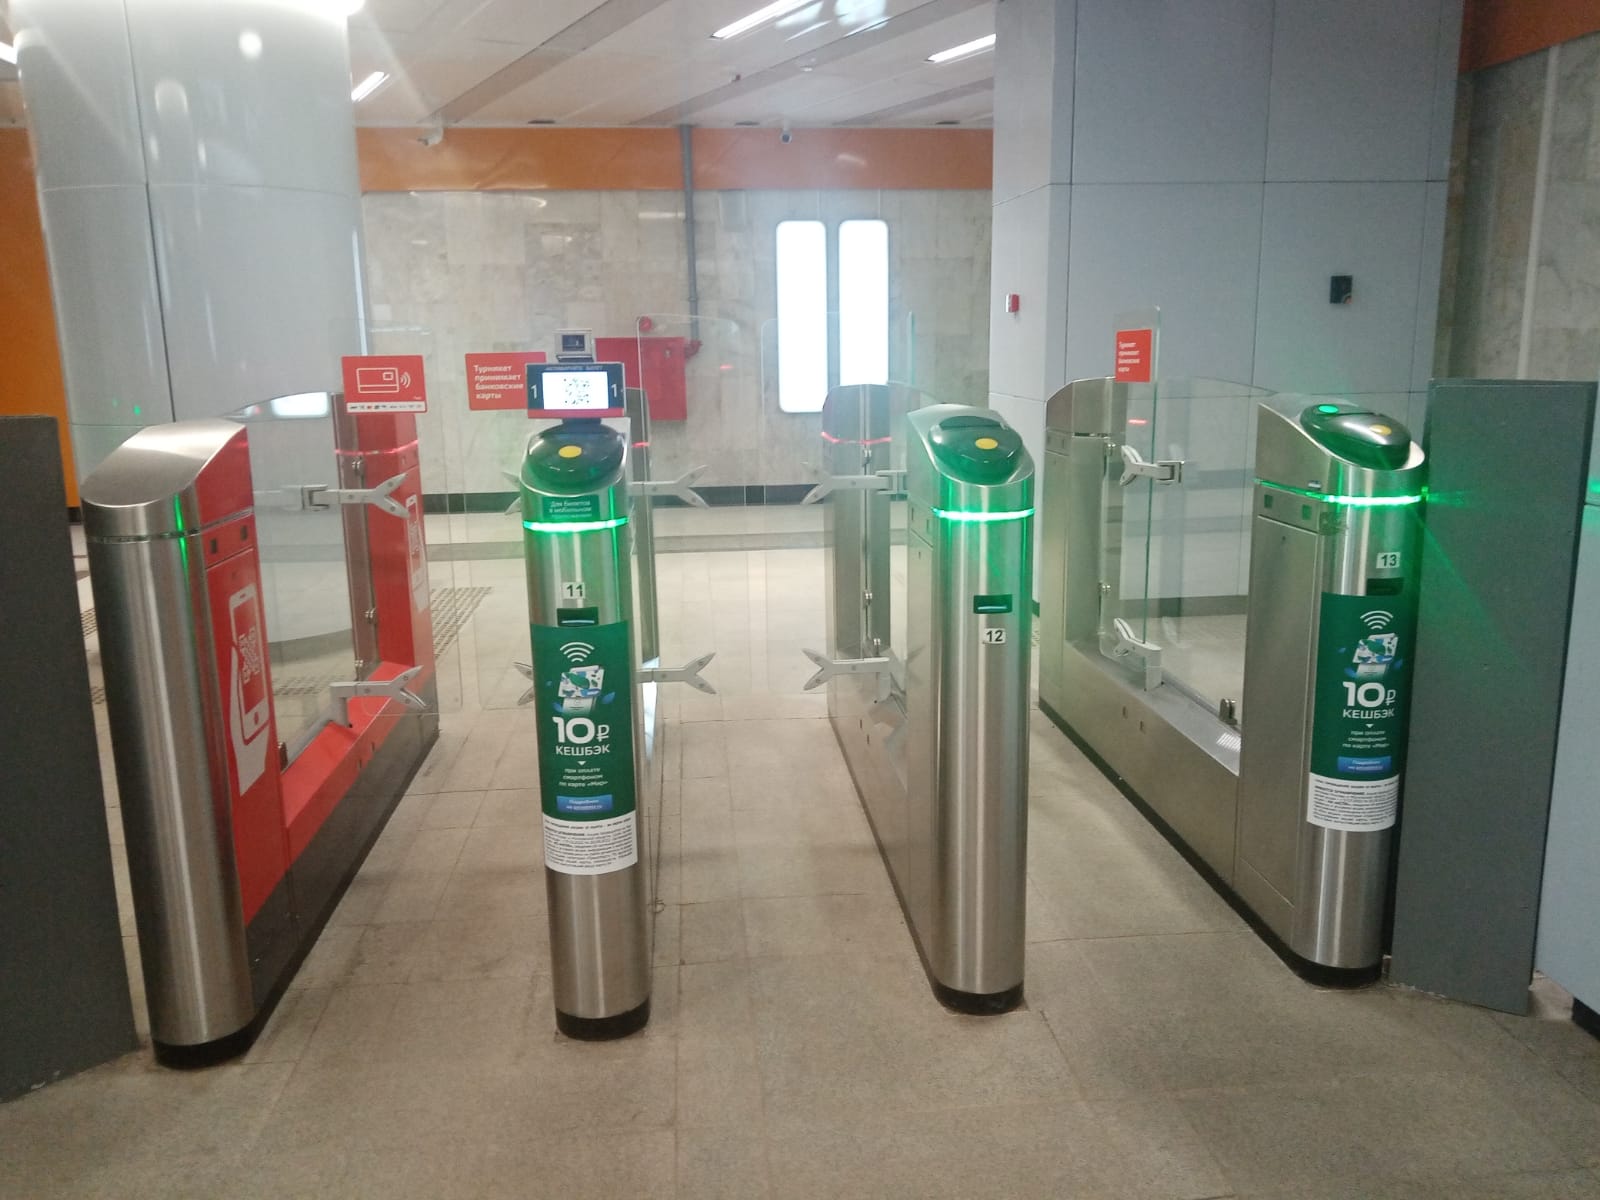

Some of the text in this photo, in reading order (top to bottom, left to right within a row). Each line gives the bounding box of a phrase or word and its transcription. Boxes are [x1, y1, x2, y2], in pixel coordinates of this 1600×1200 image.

[530, 384, 538, 399] 1
[611, 383, 618, 398] 1
[1381, 554, 1397, 567] 13
[566, 584, 584, 597] 11
[986, 630, 1003, 643] 12
[1343, 708, 1394, 719] КЕШБЭК
[555, 744, 611, 756] КЕШБЭК
